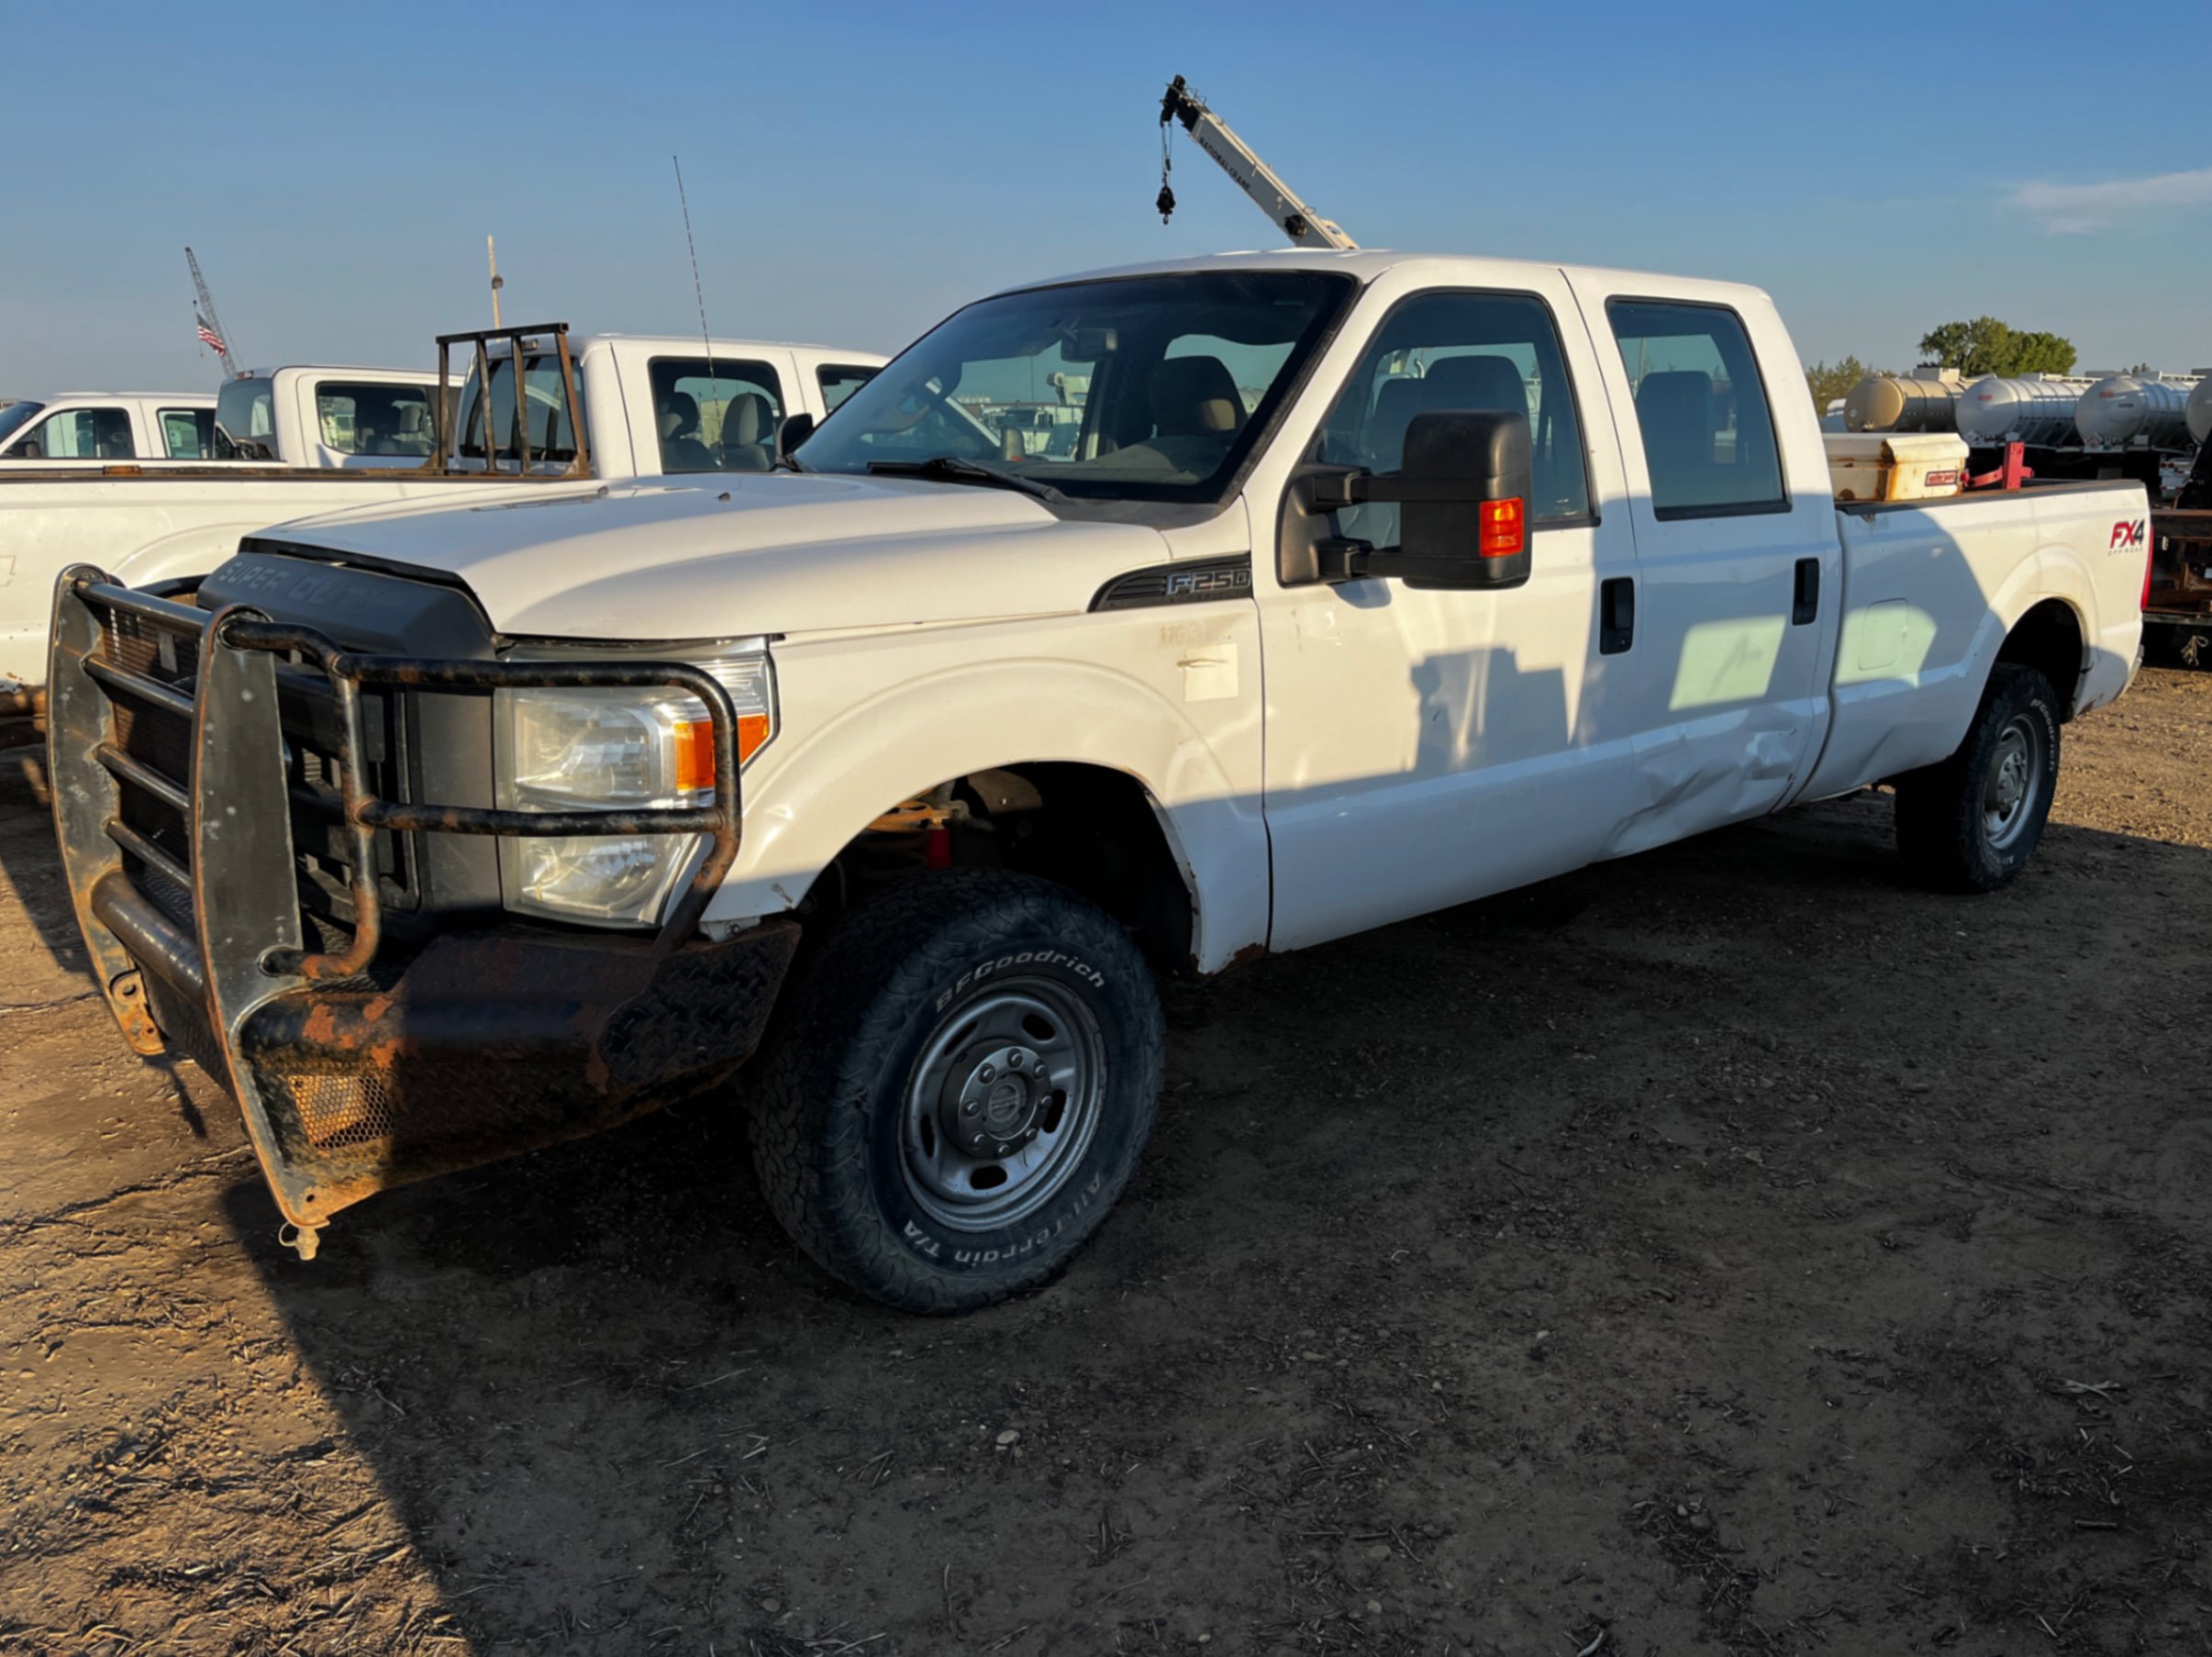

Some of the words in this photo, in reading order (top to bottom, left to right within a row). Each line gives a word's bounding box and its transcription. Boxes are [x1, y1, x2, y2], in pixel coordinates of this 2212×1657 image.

[1199, 137, 1229, 172] NATIONAL
[1228, 167, 1251, 192] CRANE
[2109, 518, 2145, 549] FX4
[218, 561, 290, 595] SUPER
[284, 573, 388, 613] DUTY
[936, 949, 1106, 1014] BFGoodrich
[903, 1218, 941, 1258] T/A
